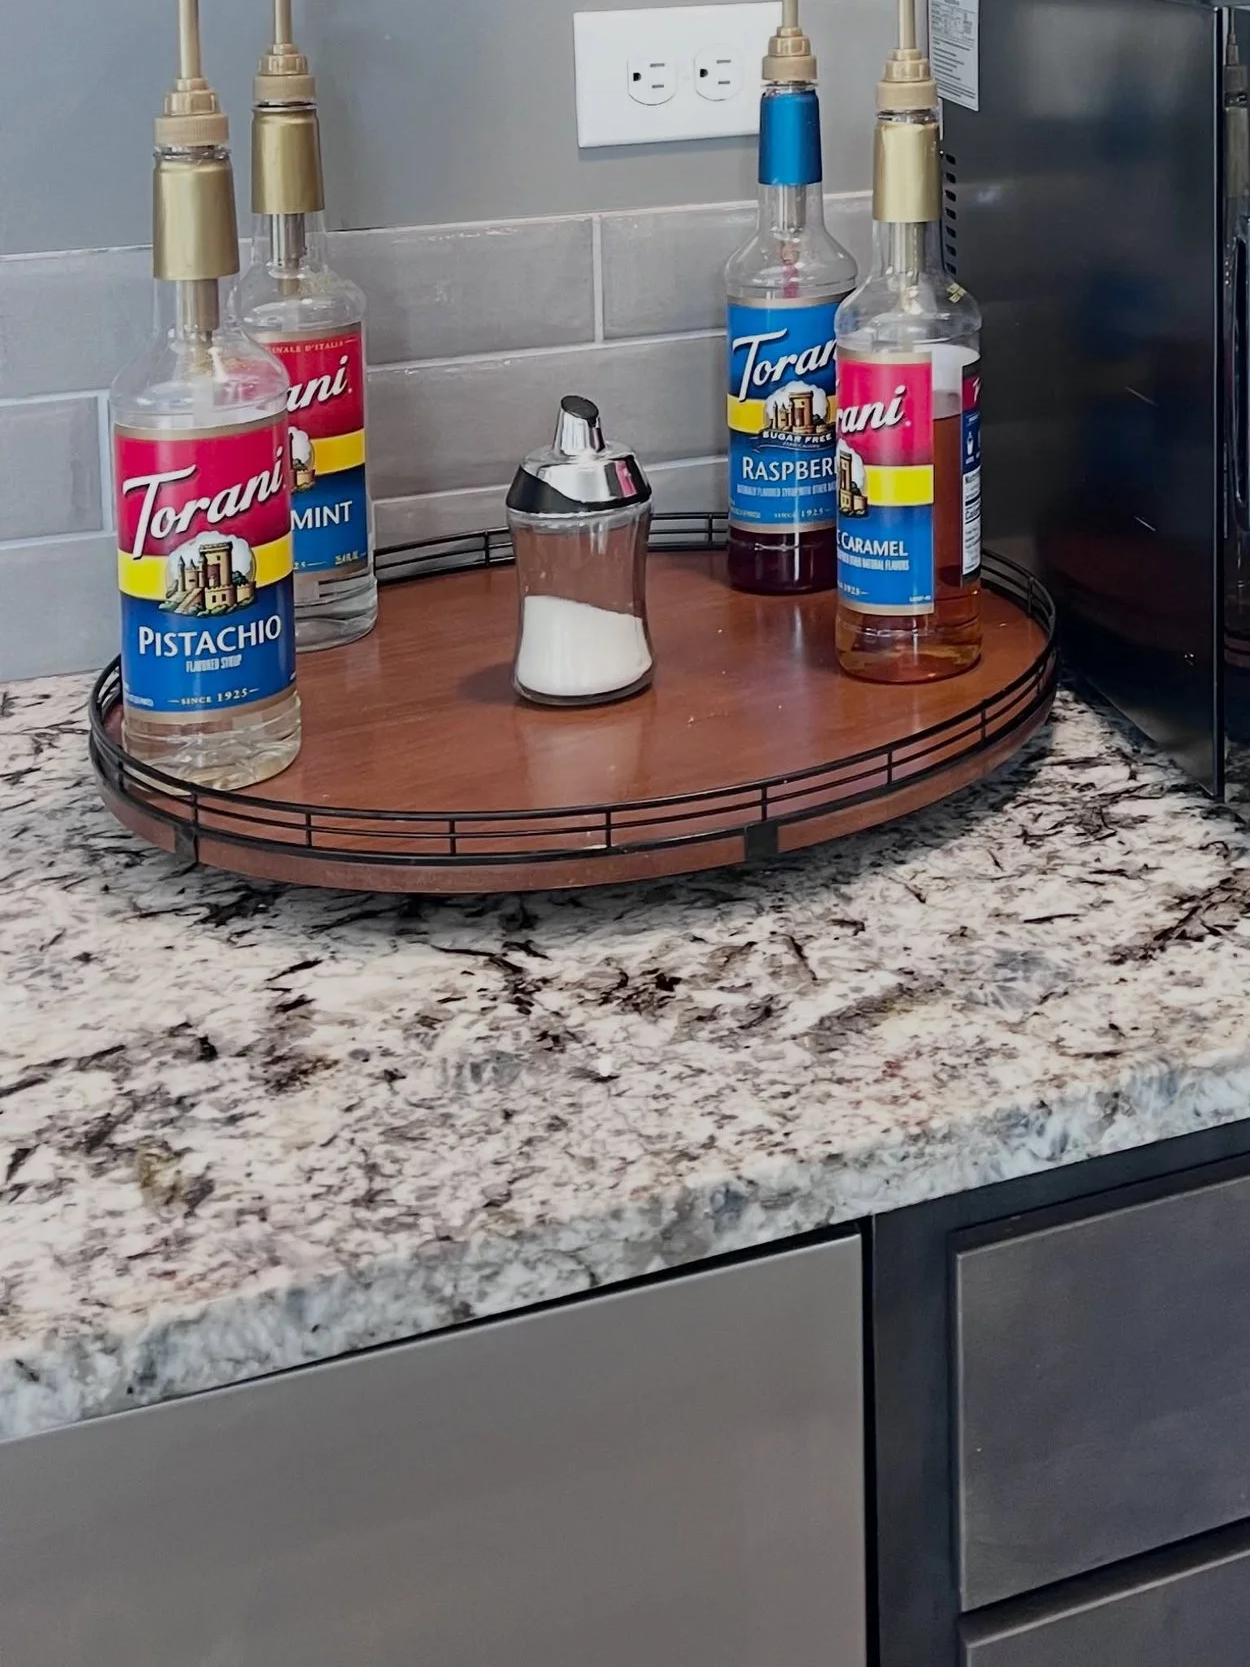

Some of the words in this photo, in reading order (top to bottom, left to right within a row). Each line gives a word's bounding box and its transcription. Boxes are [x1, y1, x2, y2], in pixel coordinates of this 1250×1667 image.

[286, 355, 349, 412] ani
[732, 327, 837, 402] Toran
[836, 385, 905, 433] rani
[762, 430, 801, 444] SUGAR
[804, 433, 833, 444] FREE
[742, 456, 837, 481] RASPBER
[122, 446, 283, 559] Torani
[841, 532, 909, 556] CARAMEL
[138, 615, 282, 657] PISTACHIO
[181, 695, 213, 706] SINCE
[217, 687, 248, 703] 1925
